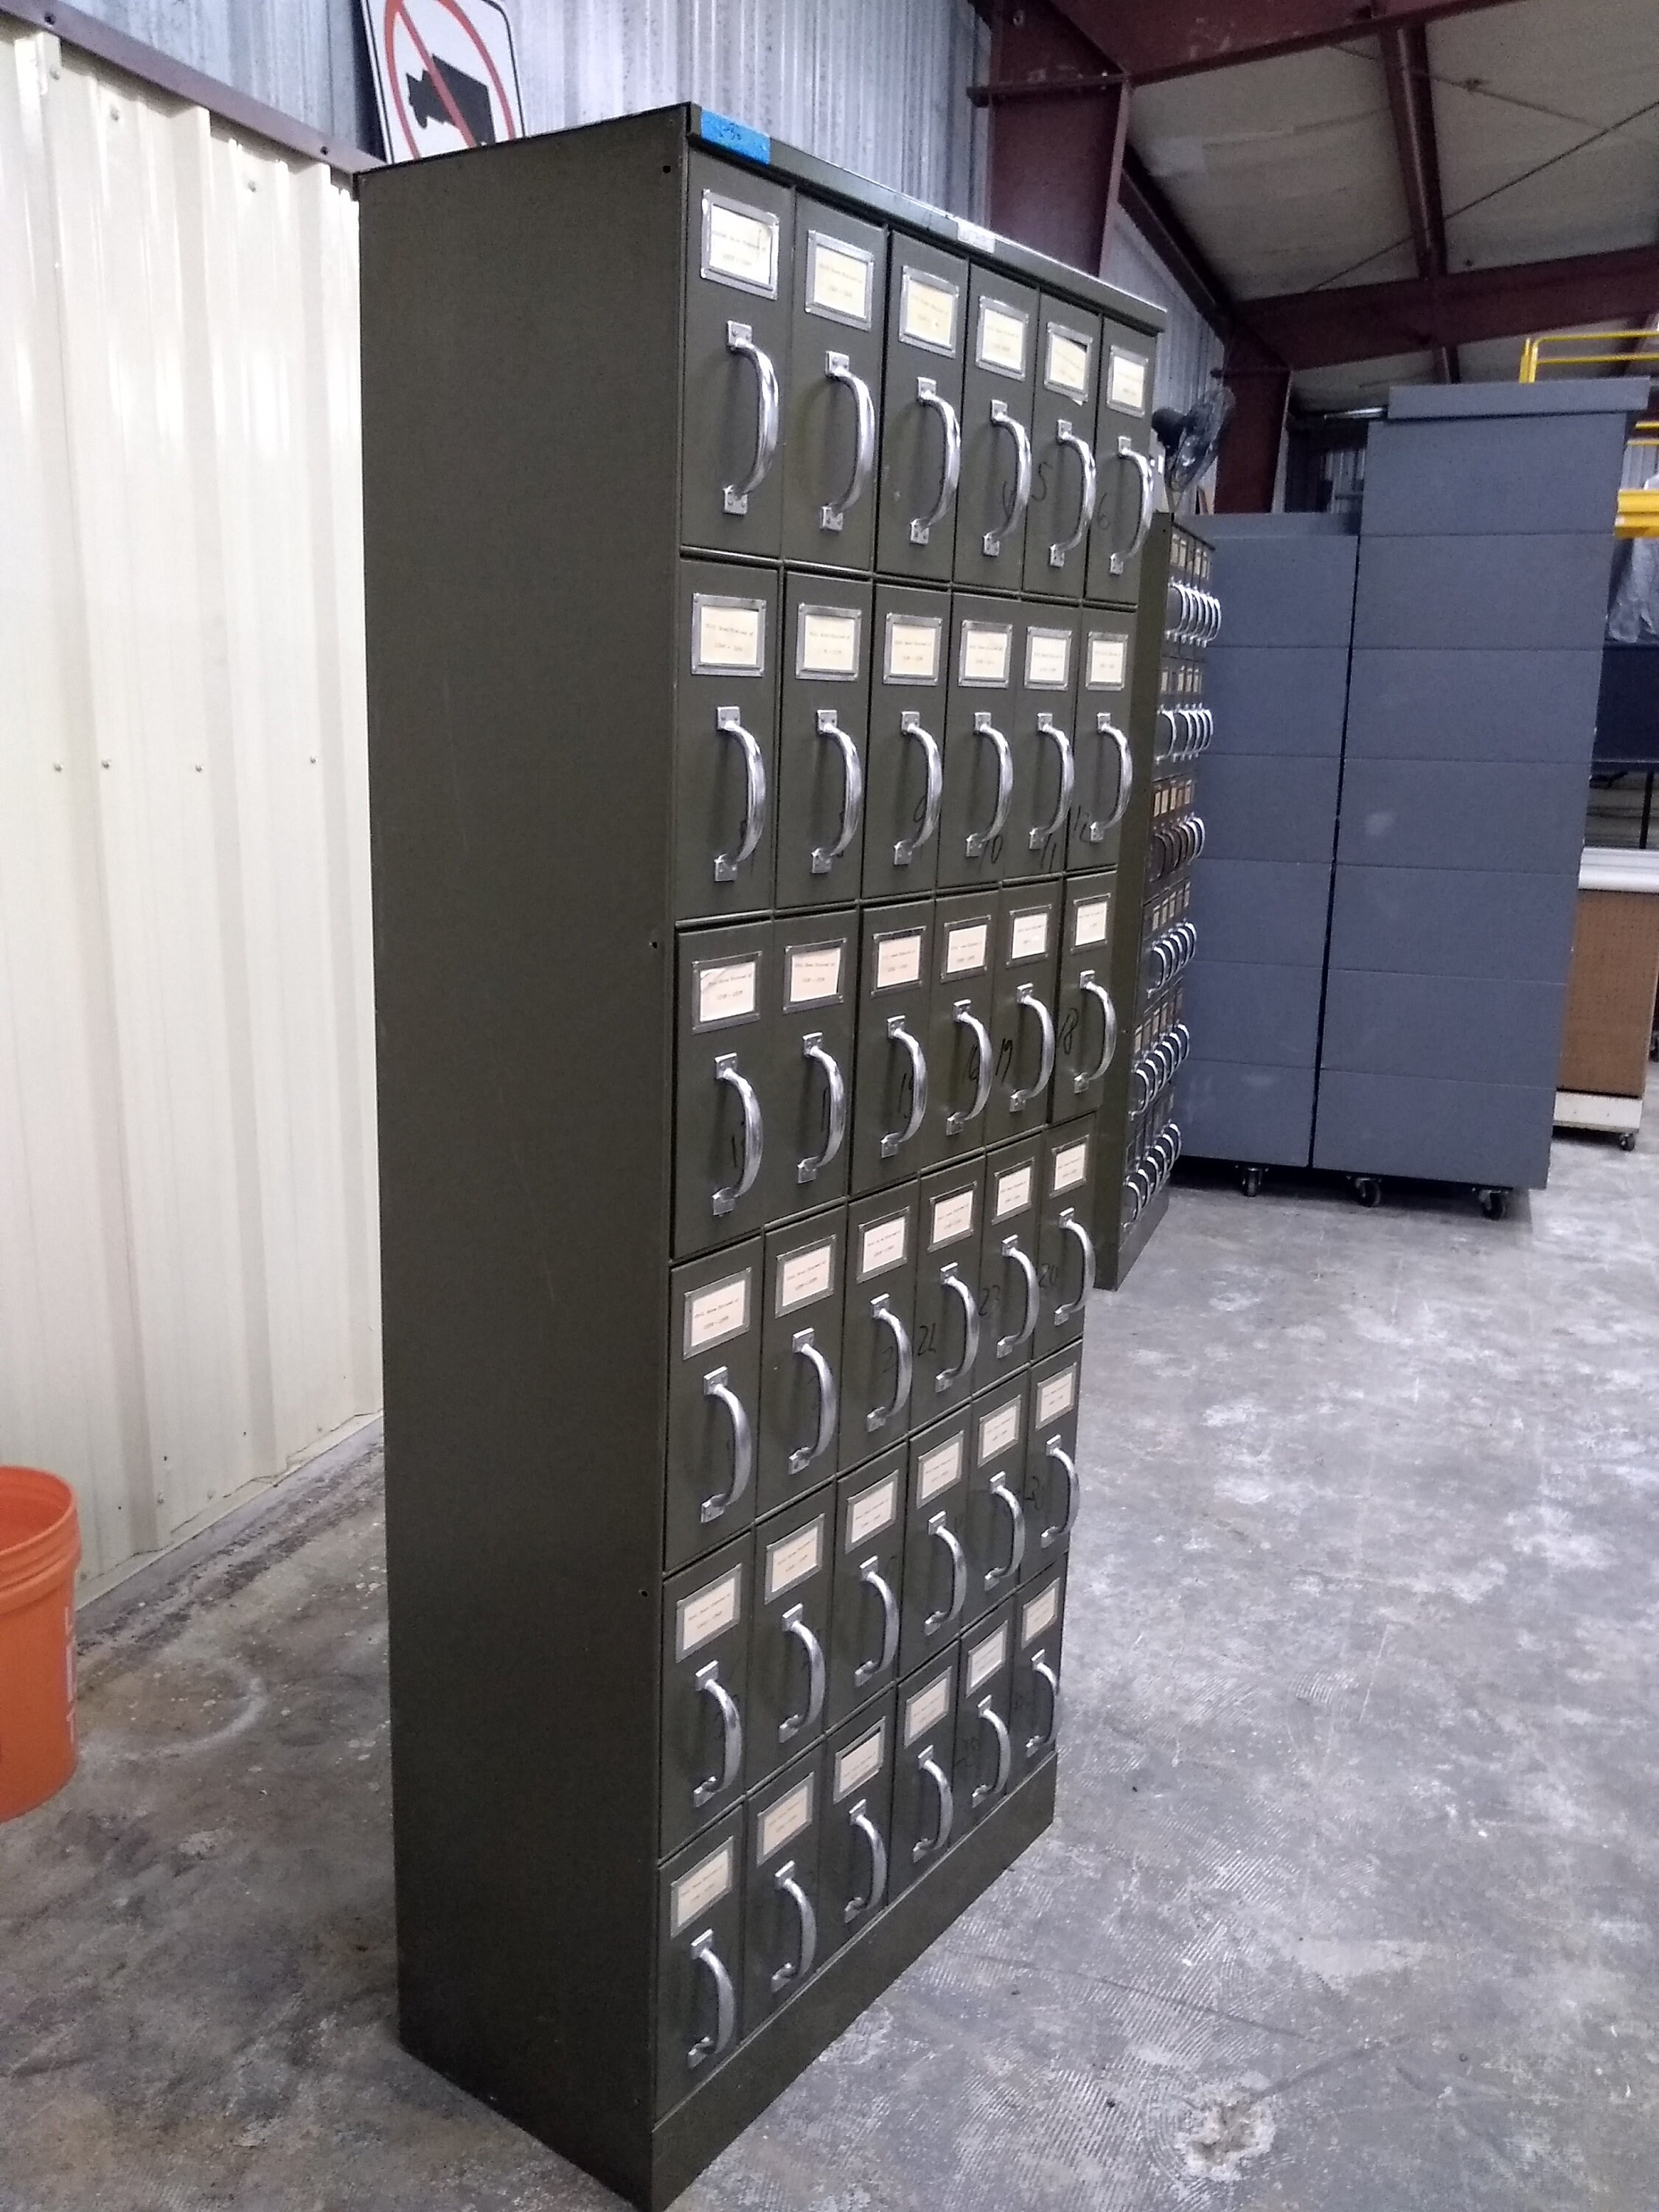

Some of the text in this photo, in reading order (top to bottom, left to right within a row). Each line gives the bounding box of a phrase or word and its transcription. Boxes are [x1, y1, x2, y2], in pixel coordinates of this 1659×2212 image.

[1097, 491, 1110, 531] 6
[978, 834, 1004, 872] 10
[1056, 1007, 1079, 1056] 18
